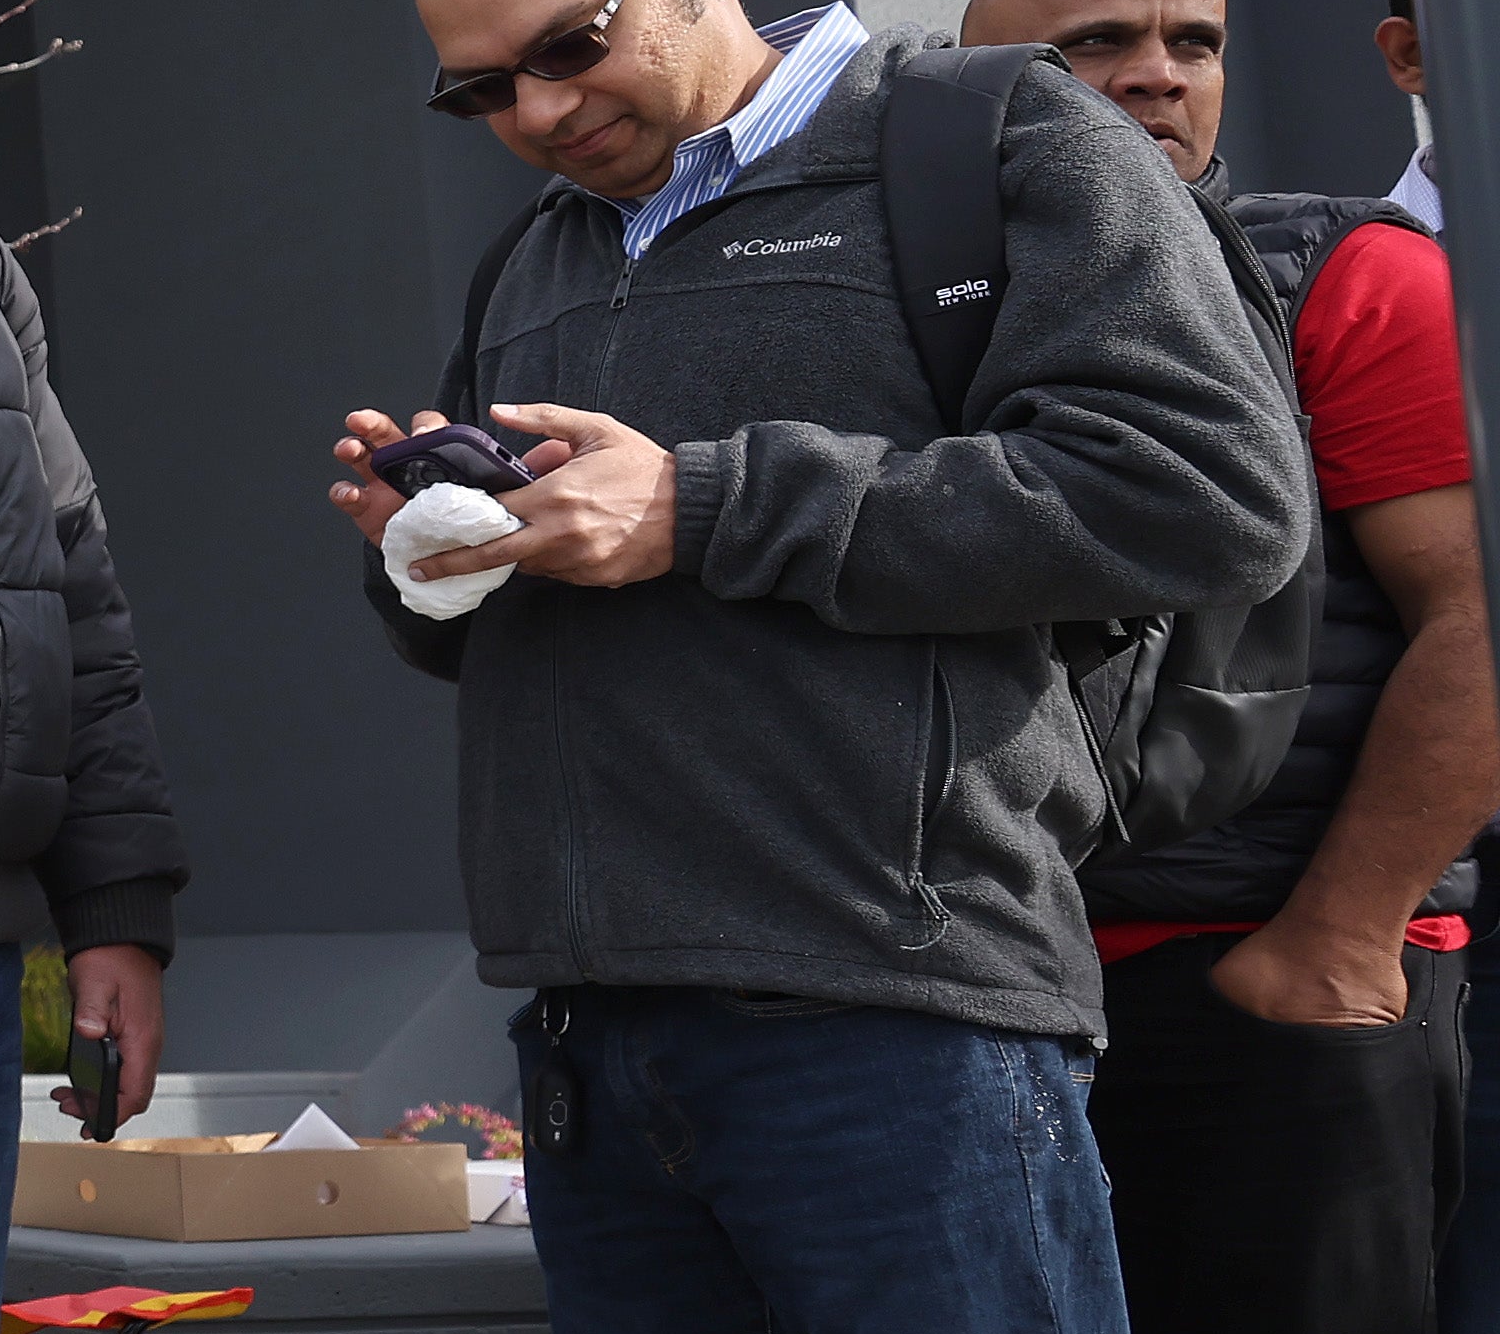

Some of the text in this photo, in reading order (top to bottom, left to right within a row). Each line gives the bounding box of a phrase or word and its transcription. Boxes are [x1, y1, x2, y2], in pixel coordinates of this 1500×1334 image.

[743, 231, 842, 256] Columbia
[936, 279, 989, 300] solo
[939, 289, 991, 307] NEW YORK
